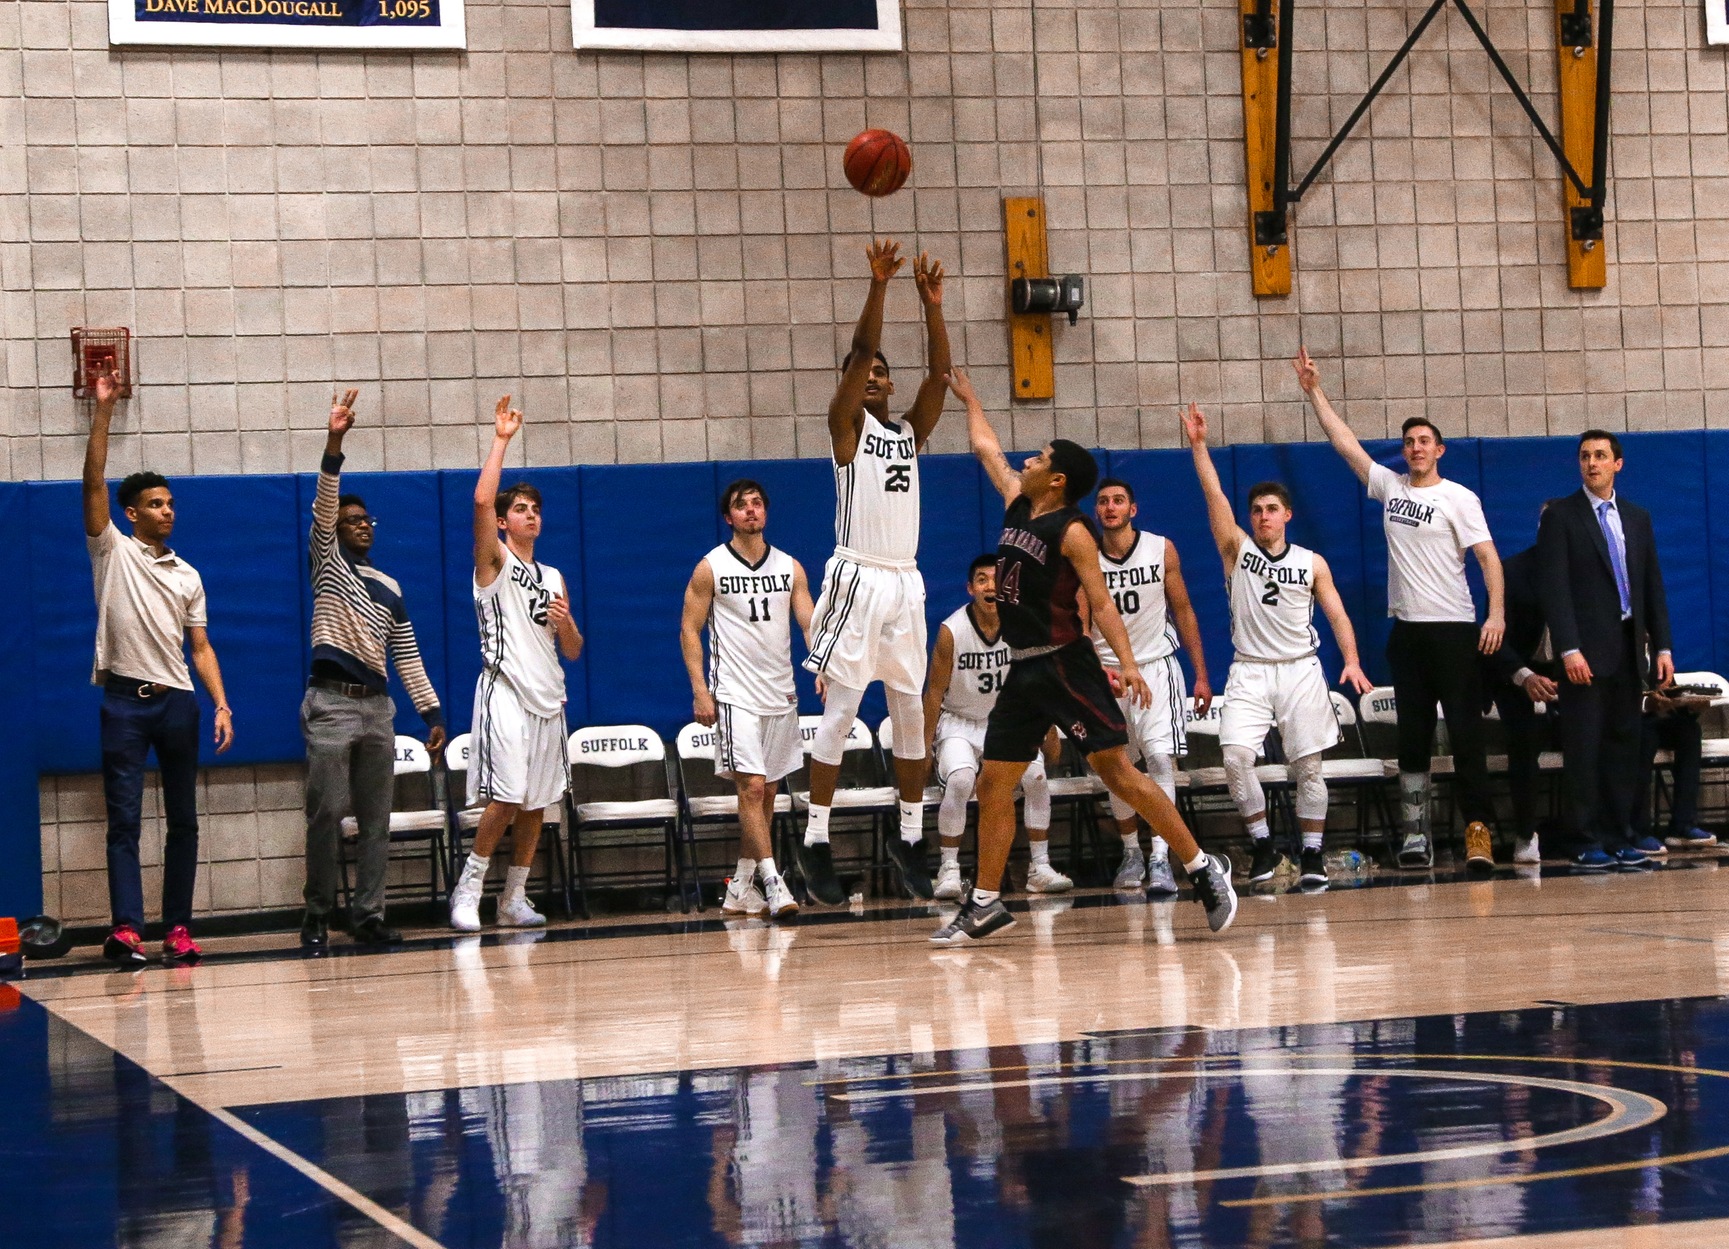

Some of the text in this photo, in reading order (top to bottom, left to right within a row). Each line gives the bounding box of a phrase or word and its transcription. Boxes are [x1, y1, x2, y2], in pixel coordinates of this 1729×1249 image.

[379, 0, 431, 19] 1,095
[885, 464, 911, 492] 25
[994, 557, 1021, 605] 14
[1102, 564, 1161, 589] FFOLK
[1241, 551, 1308, 586] SUFFOLK
[719, 574, 790, 595] SUFFOLK
[1262, 580, 1280, 606] 2
[748, 597, 771, 622] 11
[1113, 590, 1140, 615] 10
[958, 648, 1011, 670] SUFFOL
[978, 670, 1003, 694] 31
[581, 738, 649, 753] SUFFOLK
